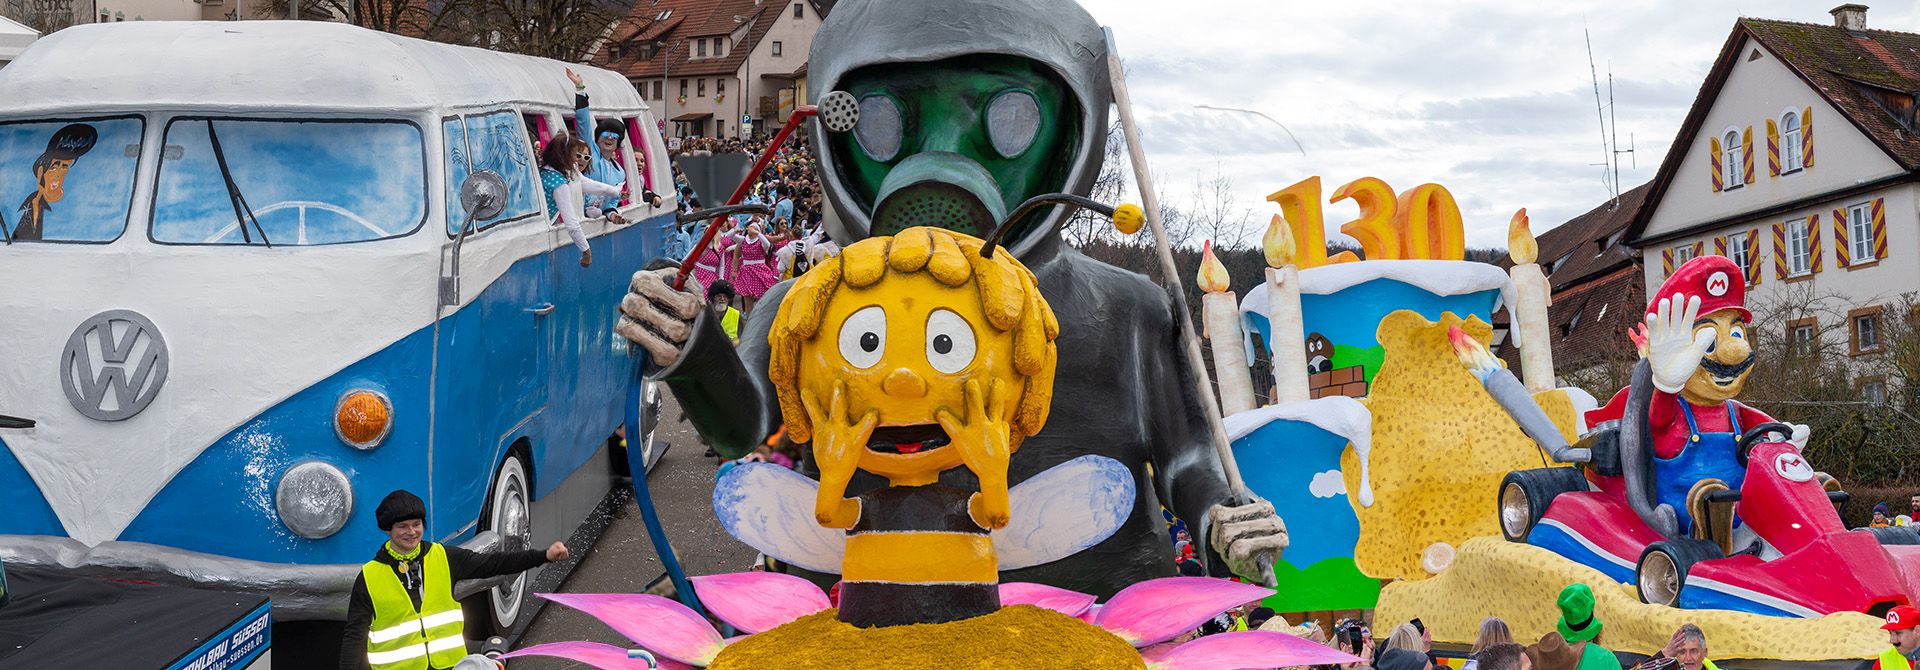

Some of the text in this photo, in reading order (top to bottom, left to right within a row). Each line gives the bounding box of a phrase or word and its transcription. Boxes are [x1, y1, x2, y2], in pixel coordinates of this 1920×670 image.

[743, 115, 750, 123] P
[1266, 176, 1465, 271] 130
[1709, 278, 1727, 291] M
[67, 314, 163, 416] VW
[1780, 457, 1811, 473] M
[1887, 612, 1898, 622] M
